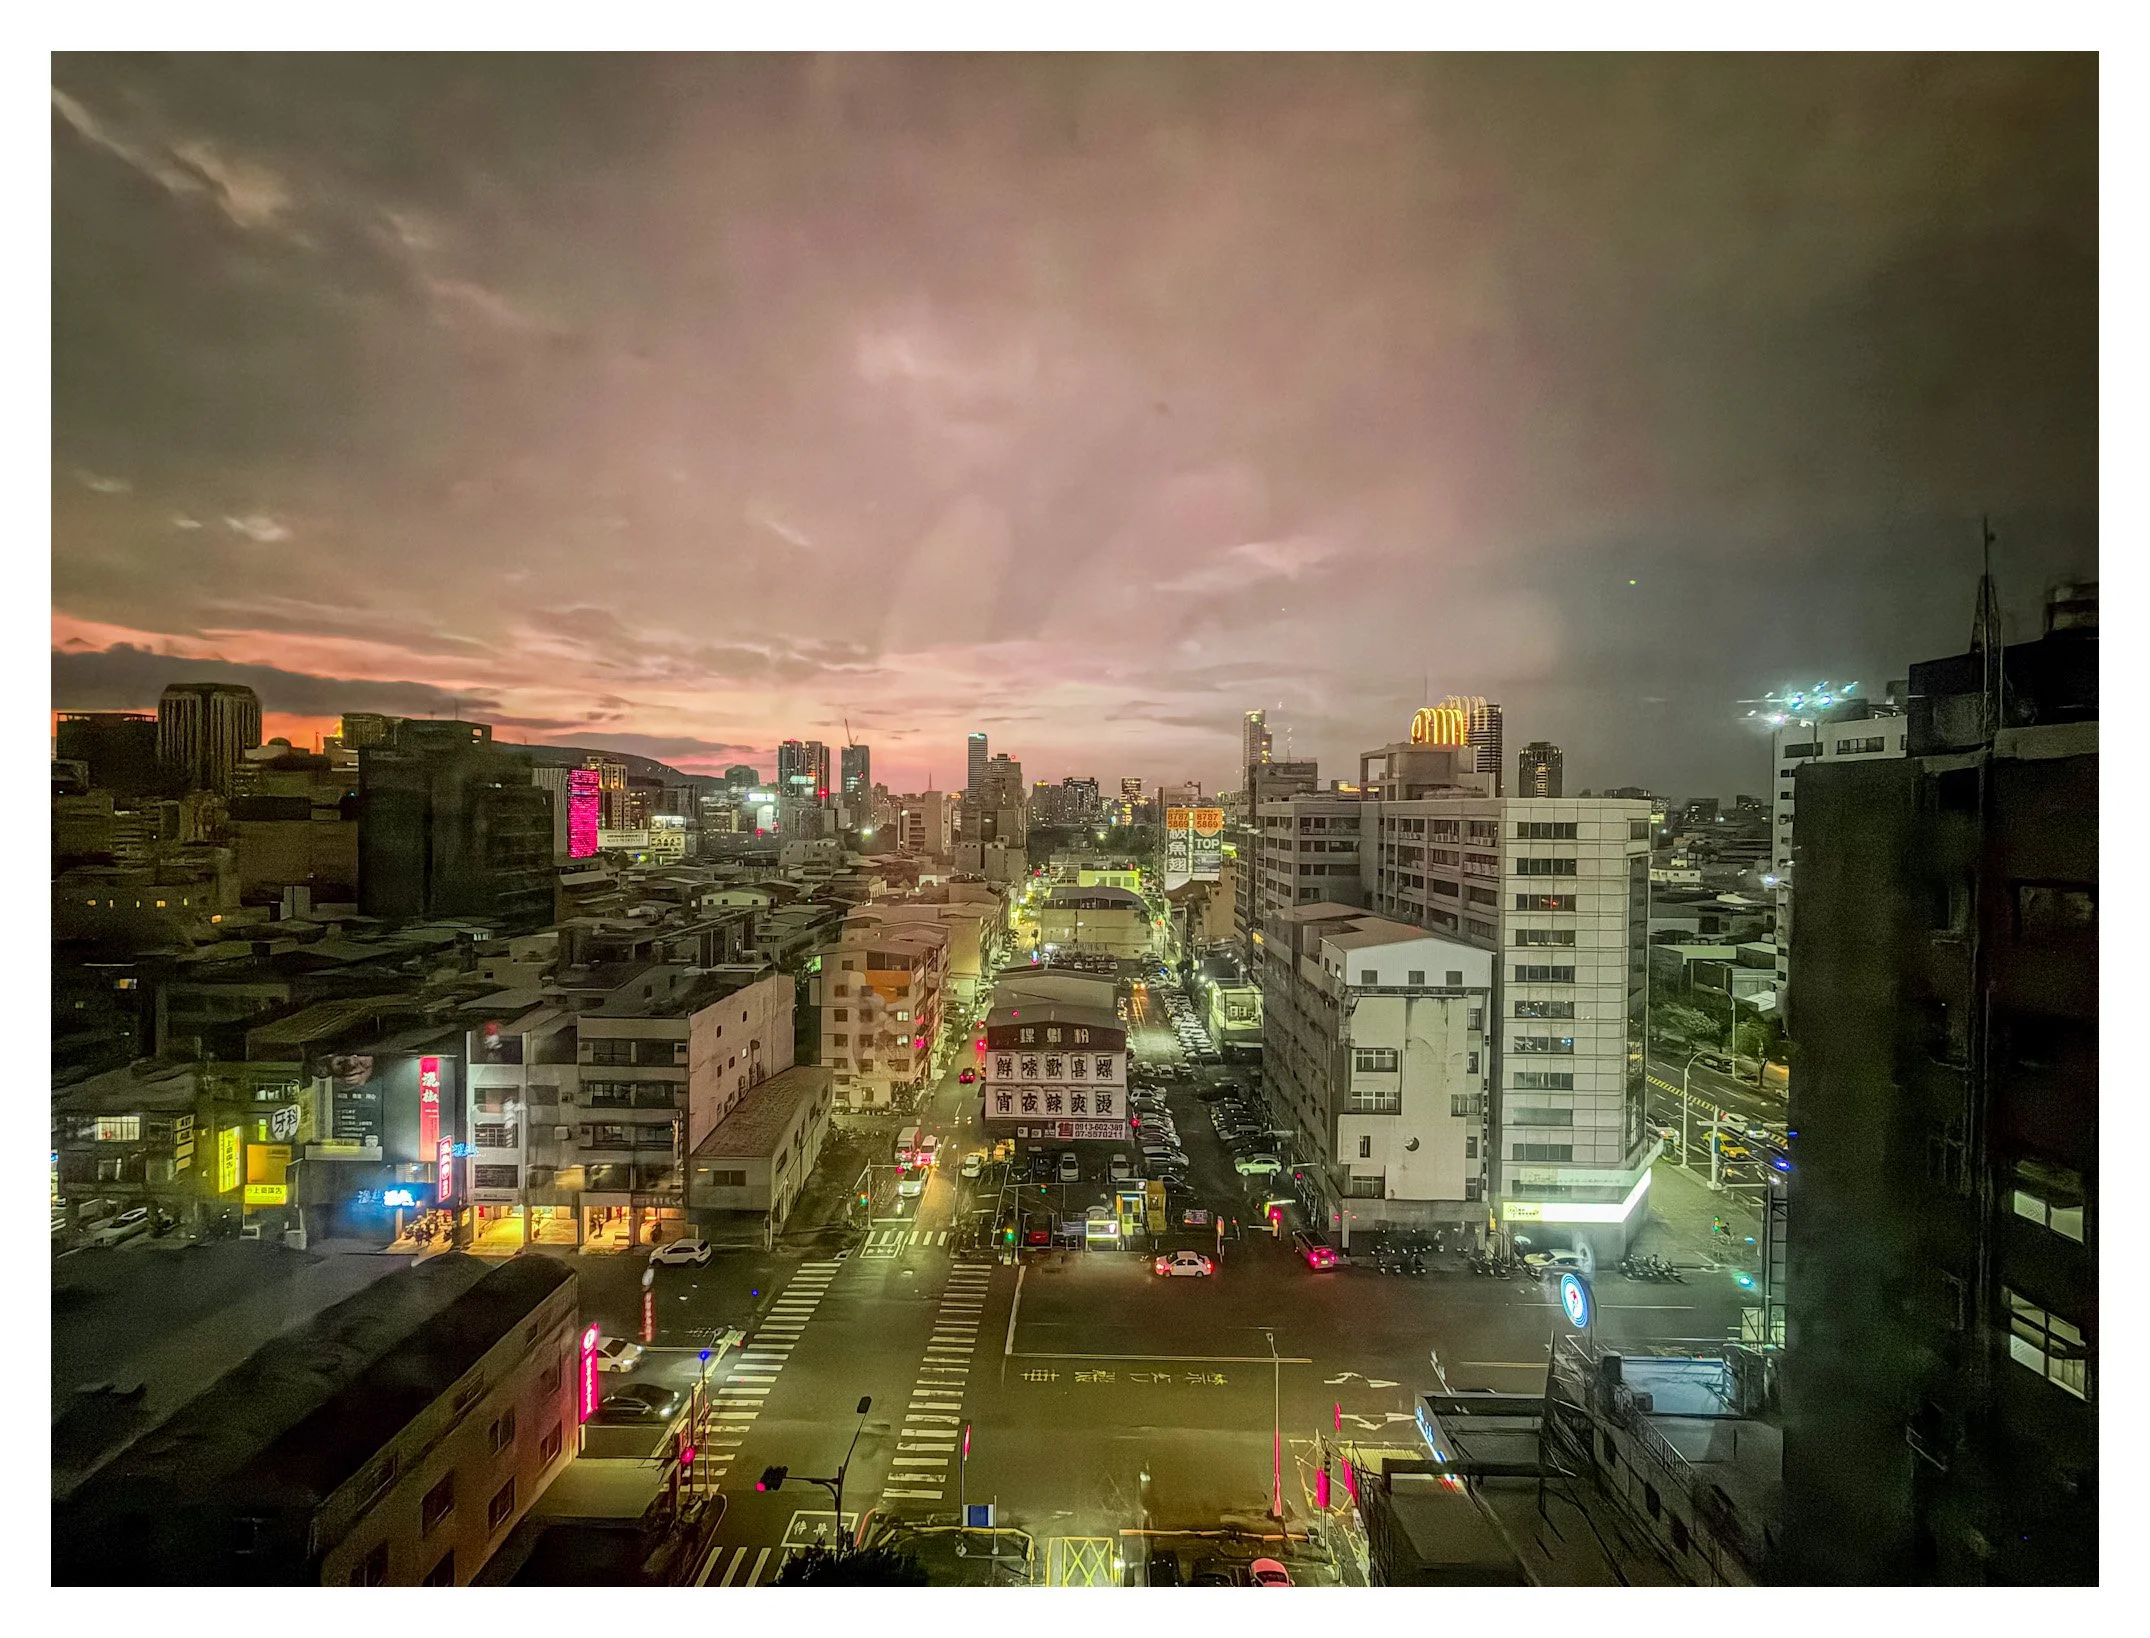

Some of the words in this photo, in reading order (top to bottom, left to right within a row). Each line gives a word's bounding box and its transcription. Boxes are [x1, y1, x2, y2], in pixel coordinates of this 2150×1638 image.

[1195, 839, 1220, 849] TOP
[275, 1109, 297, 1133] 牙科
[1057, 1121, 1073, 1137] 售
